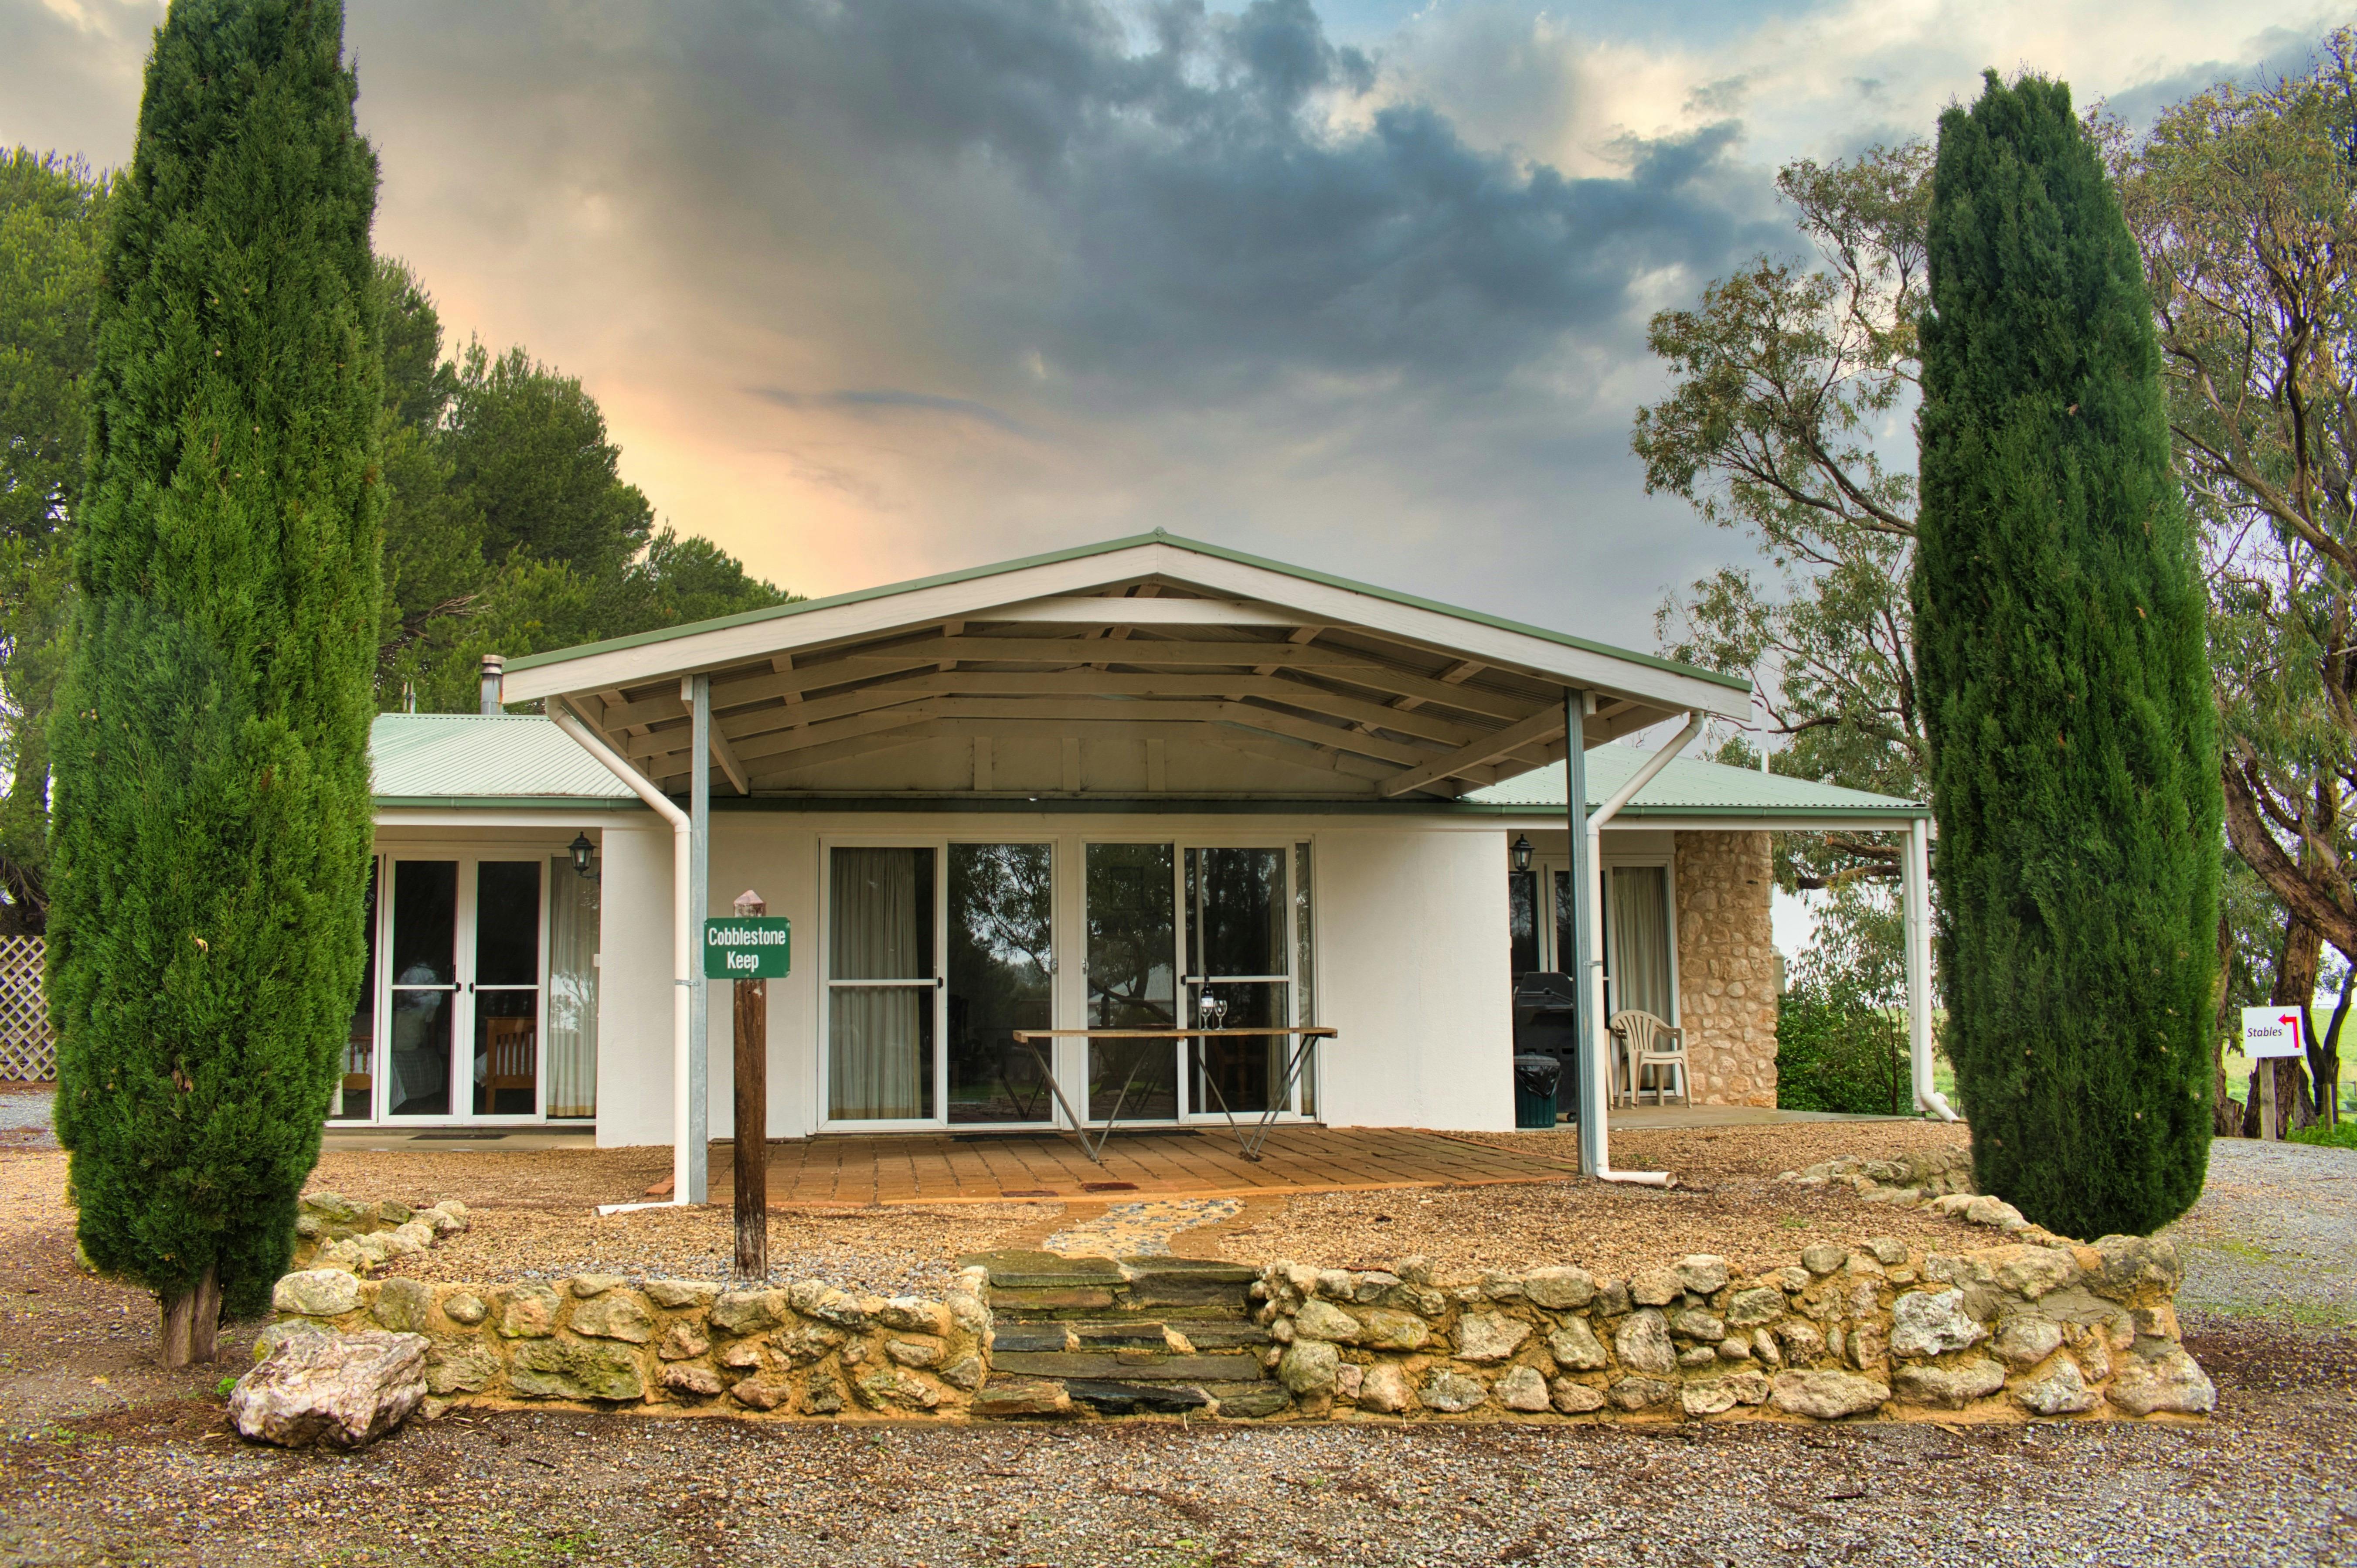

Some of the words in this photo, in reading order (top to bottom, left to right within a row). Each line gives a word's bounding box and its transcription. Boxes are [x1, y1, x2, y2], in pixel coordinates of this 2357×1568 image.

[709, 927, 786, 946] Cobblestone
[727, 951, 759, 973] Keep
[2247, 1027, 2282, 1037] Stables
